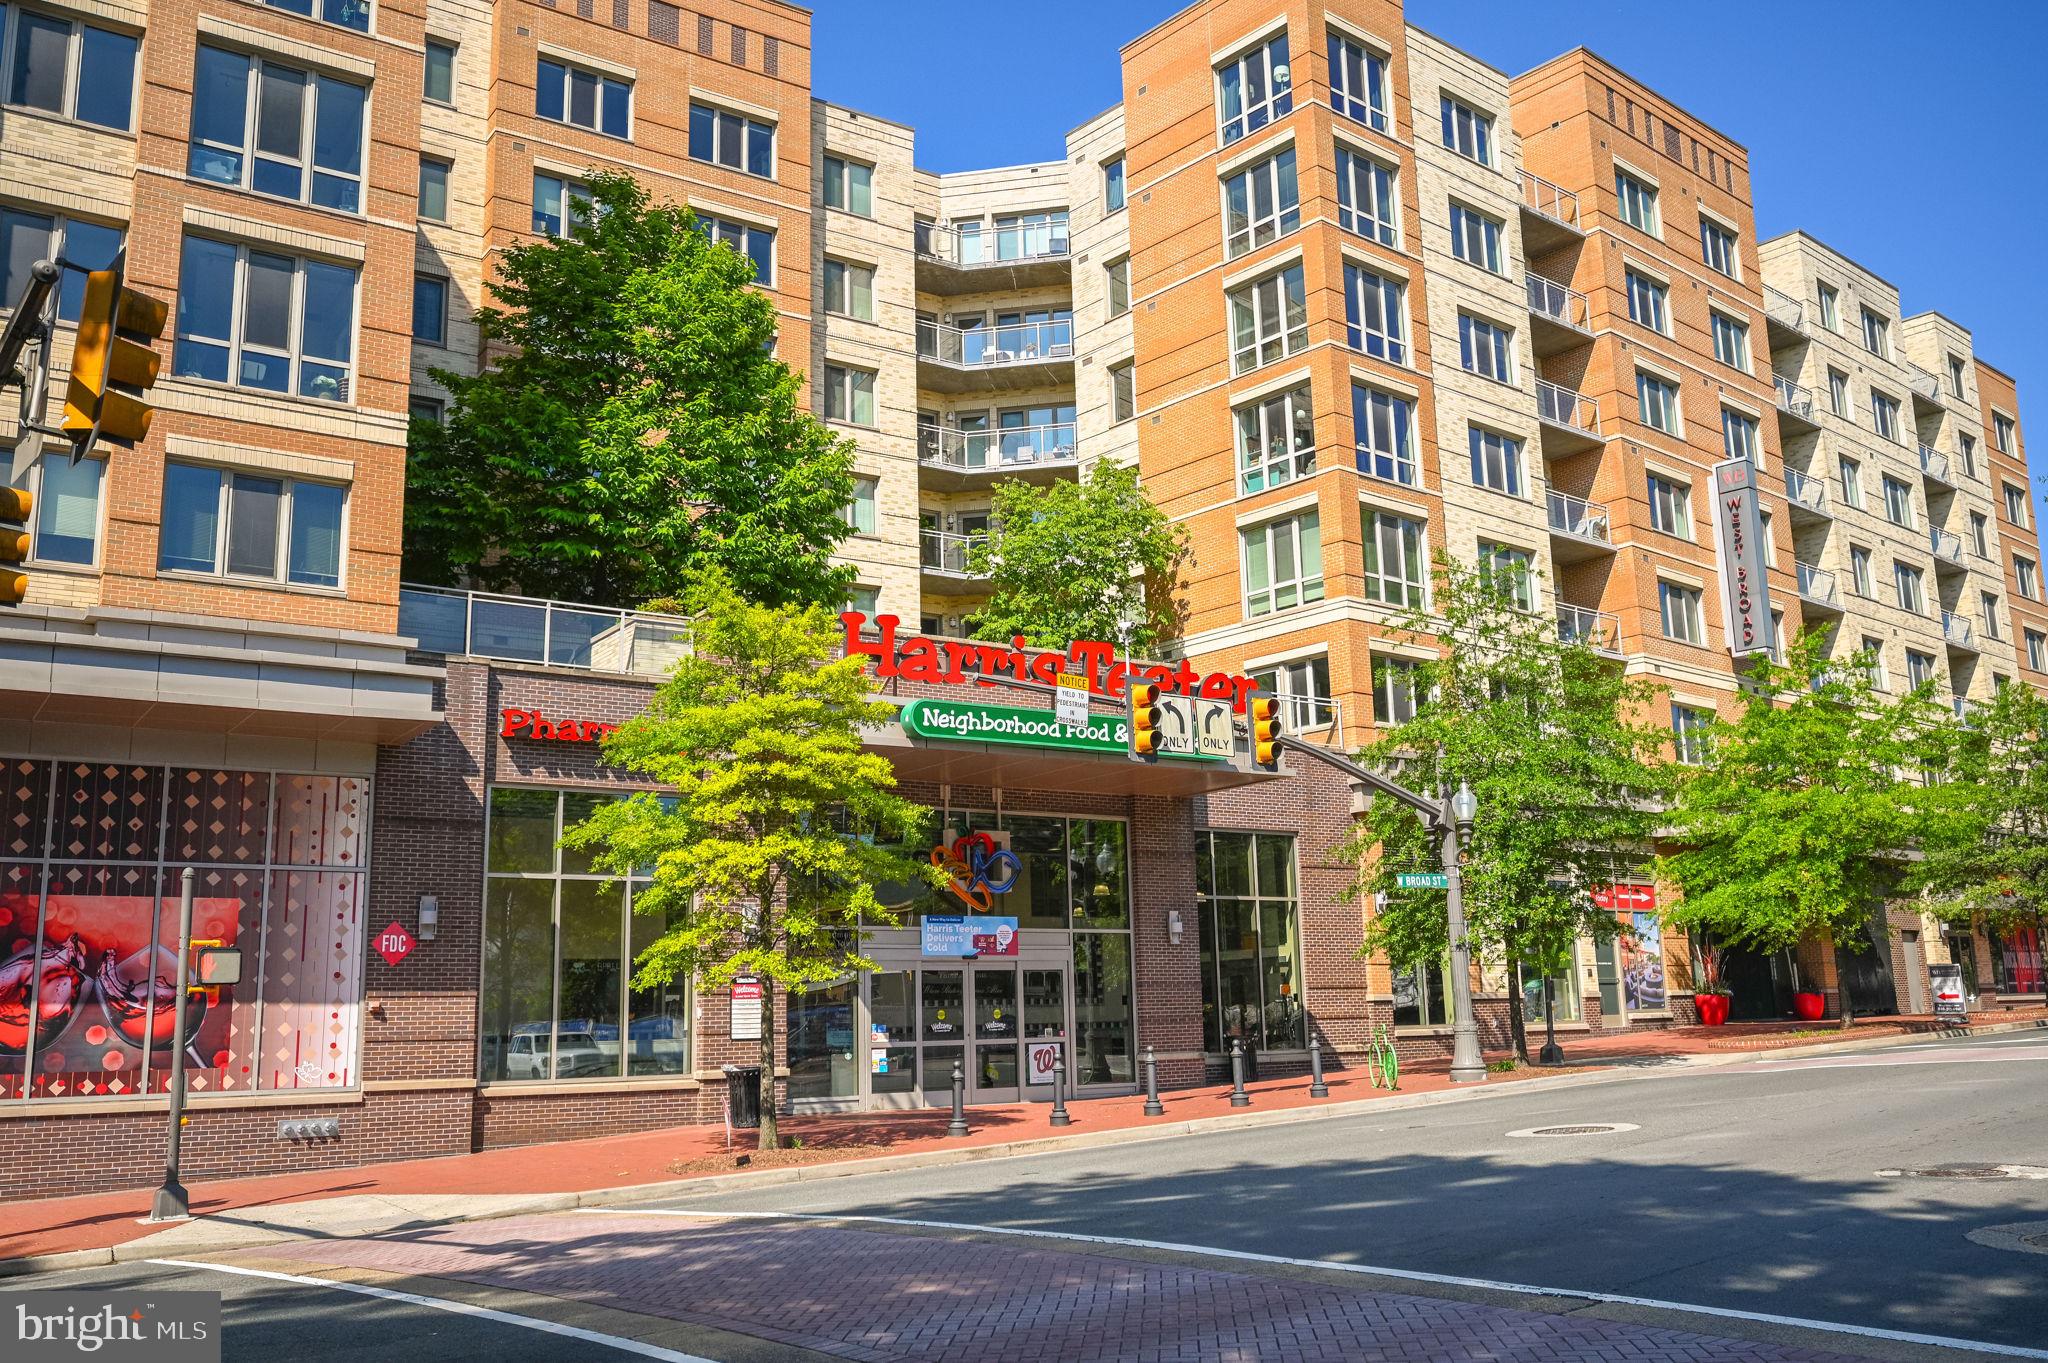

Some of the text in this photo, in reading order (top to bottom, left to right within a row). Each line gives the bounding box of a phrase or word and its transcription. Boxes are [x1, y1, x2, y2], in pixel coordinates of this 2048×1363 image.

[1726, 496, 1755, 647] WEST BROAD
[840, 611, 1260, 714] Harris Teeter
[1059, 675, 1087, 689] NOTICE
[1062, 690, 1075, 698] YIELD
[921, 707, 1130, 742] Neighborhood Food &
[1056, 716, 1087, 726] CROSSWALKS
[1203, 736, 1229, 751] ONLY
[1397, 876, 1441, 886] W BROAD ST
[927, 924, 982, 933] Harris Teeter
[382, 934, 406, 952] FDC
[927, 934, 963, 942] Delivers
[927, 943, 948, 951] Cold
[931, 1022, 953, 1030] Welcome
[985, 1021, 1006, 1029] Welcome
